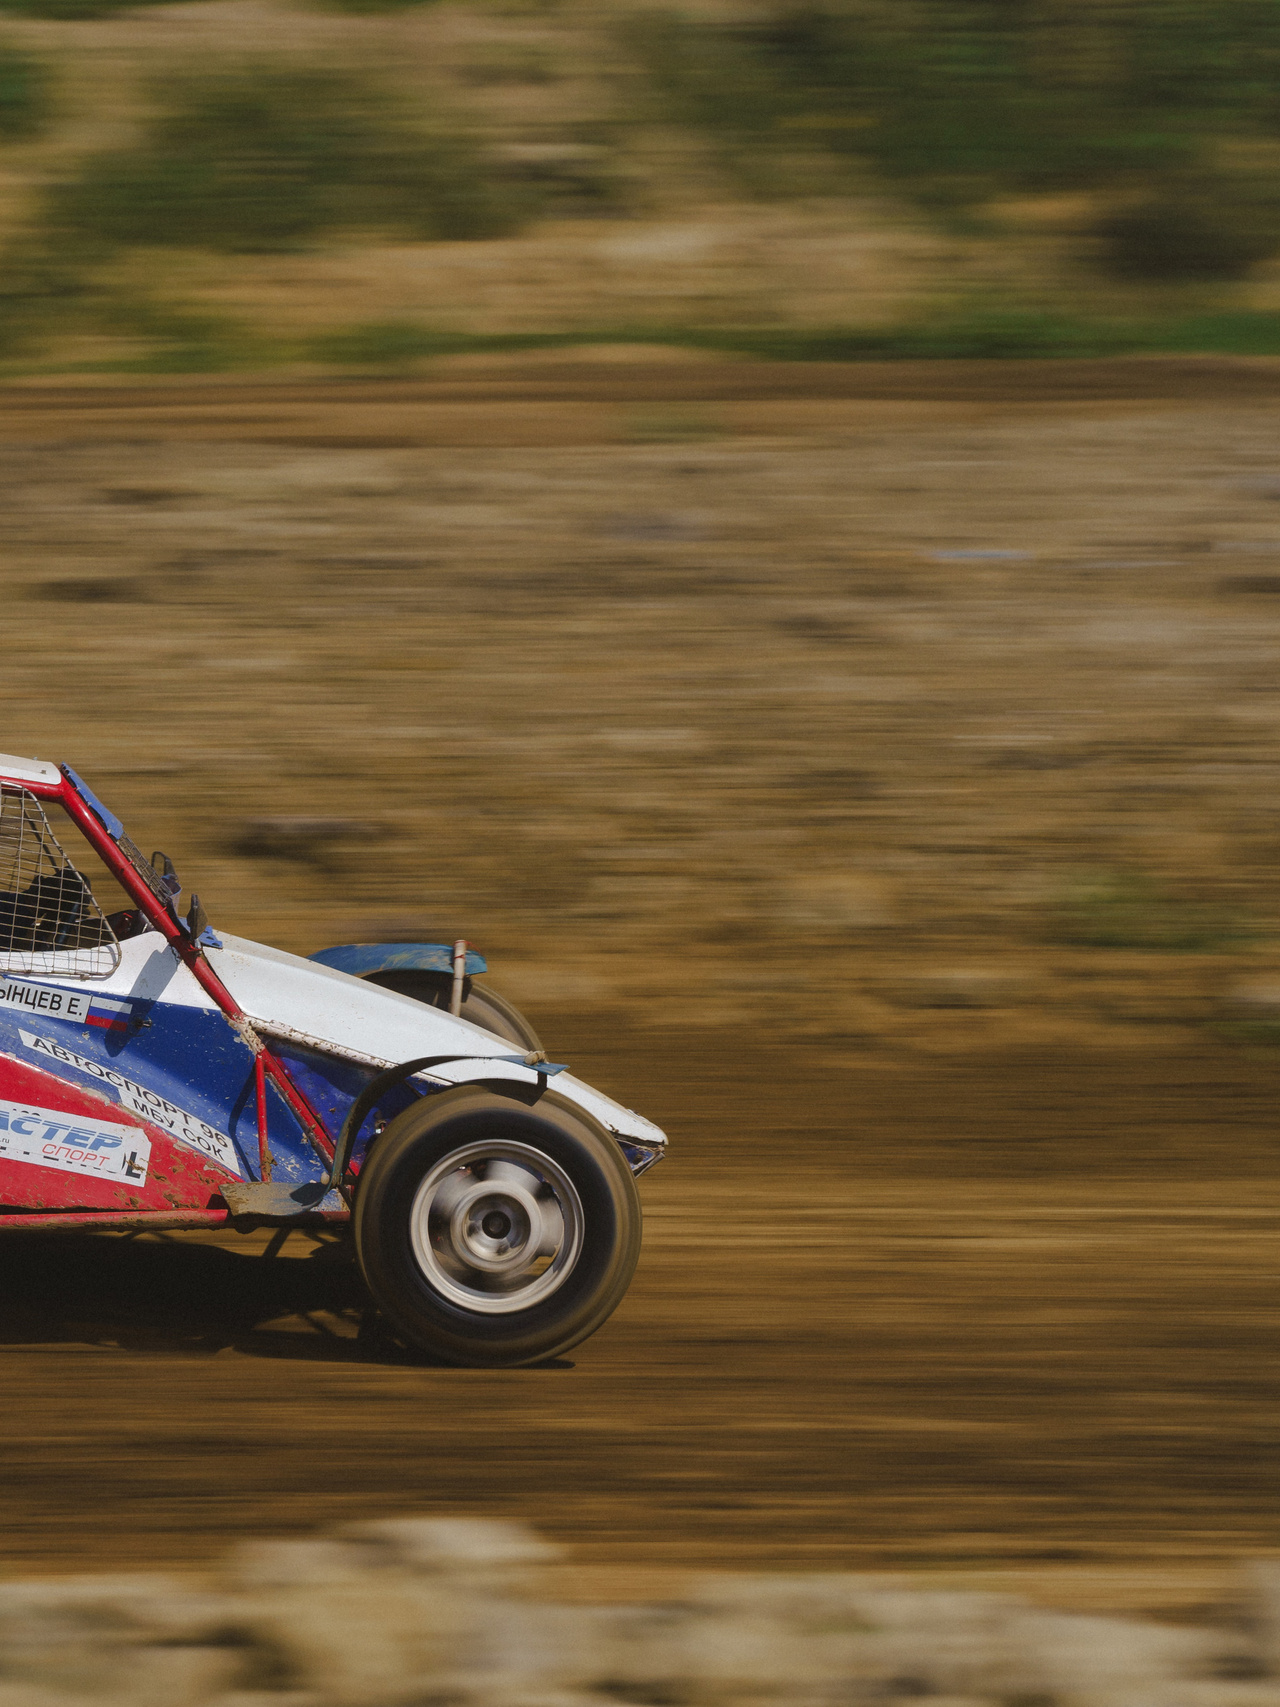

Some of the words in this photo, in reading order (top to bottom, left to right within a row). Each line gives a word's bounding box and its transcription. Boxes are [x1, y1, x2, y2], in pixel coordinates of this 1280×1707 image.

[66, 997, 83, 1016] Е.
[32, 1037, 193, 1126] АВТОСПОРТ
[200, 1123, 228, 1148] 96
[132, 1098, 175, 1129] МБУ
[182, 1127, 225, 1162] СОК
[41, 1143, 110, 1167] СПОРТ
